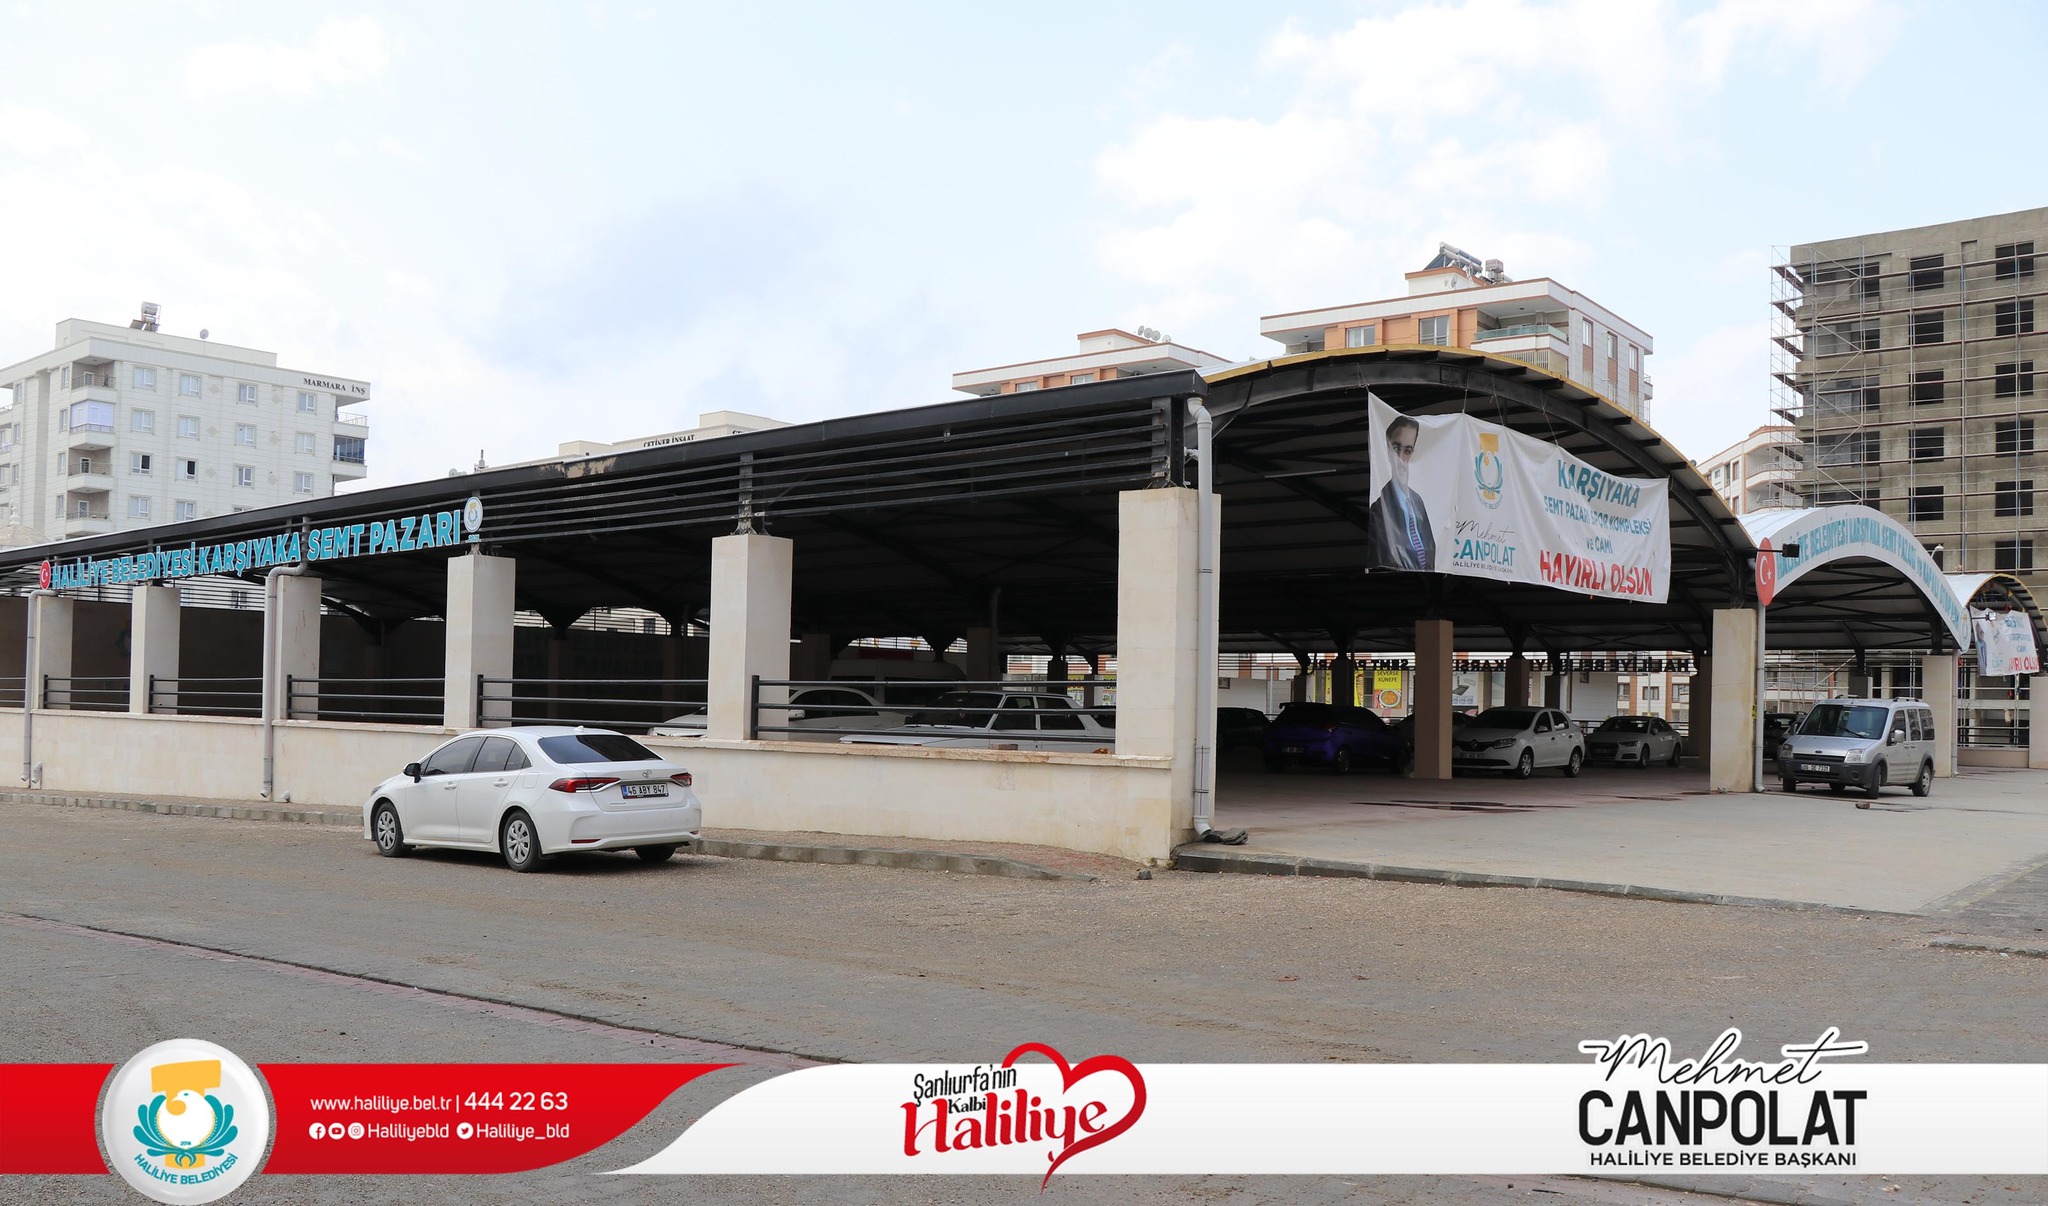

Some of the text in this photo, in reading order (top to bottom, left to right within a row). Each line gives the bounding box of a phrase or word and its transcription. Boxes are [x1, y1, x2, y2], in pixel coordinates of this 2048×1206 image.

[303, 377, 366, 395] MARMARA İNŞ
[1557, 459, 1641, 509] KARŞIYAKA
[1543, 495, 1564, 515] SEMT
[1591, 510, 1609, 530] SPOR
[1455, 519, 1516, 544] Mehmet
[1594, 535, 1613, 555] CAMİ
[50, 509, 461, 590] HALİLİYE BELEDİYESİ KARŞIYAKA SEMT PAZARI
[1539, 549, 1654, 596] HAYIRLI OLSUN
[627, 784, 665, 795] 46 ABY 847
